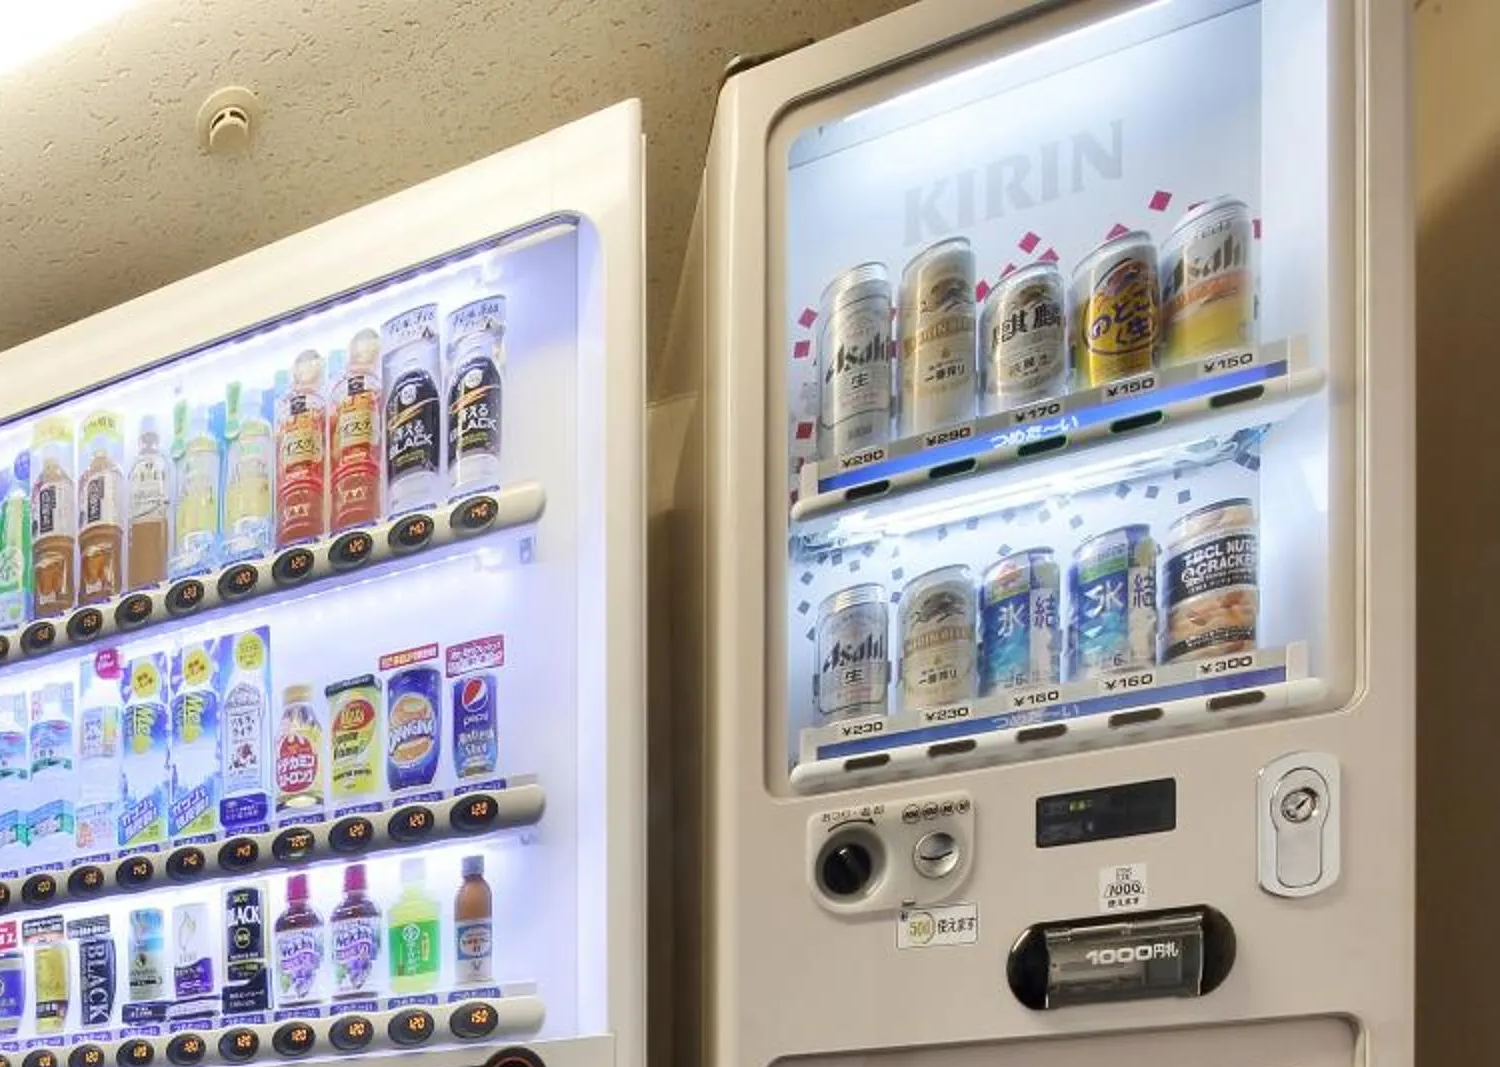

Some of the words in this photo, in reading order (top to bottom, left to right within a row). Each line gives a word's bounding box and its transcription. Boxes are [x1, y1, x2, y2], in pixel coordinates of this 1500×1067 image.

[900, 120, 1125, 246] KIRIN
[825, 332, 890, 385] Asahi
[1015, 402, 1061, 423] ¥170
[823, 633, 883, 672] Asahi
[1200, 656, 1253, 674] ¥300
[1105, 673, 1153, 690] ¥160
[925, 707, 969, 721] ¥230
[842, 721, 883, 737] ¥230
[937, 917, 977, 935] 使えます
[1085, 941, 1180, 966] 1000円札
[86, 940, 110, 1026] BLACK
